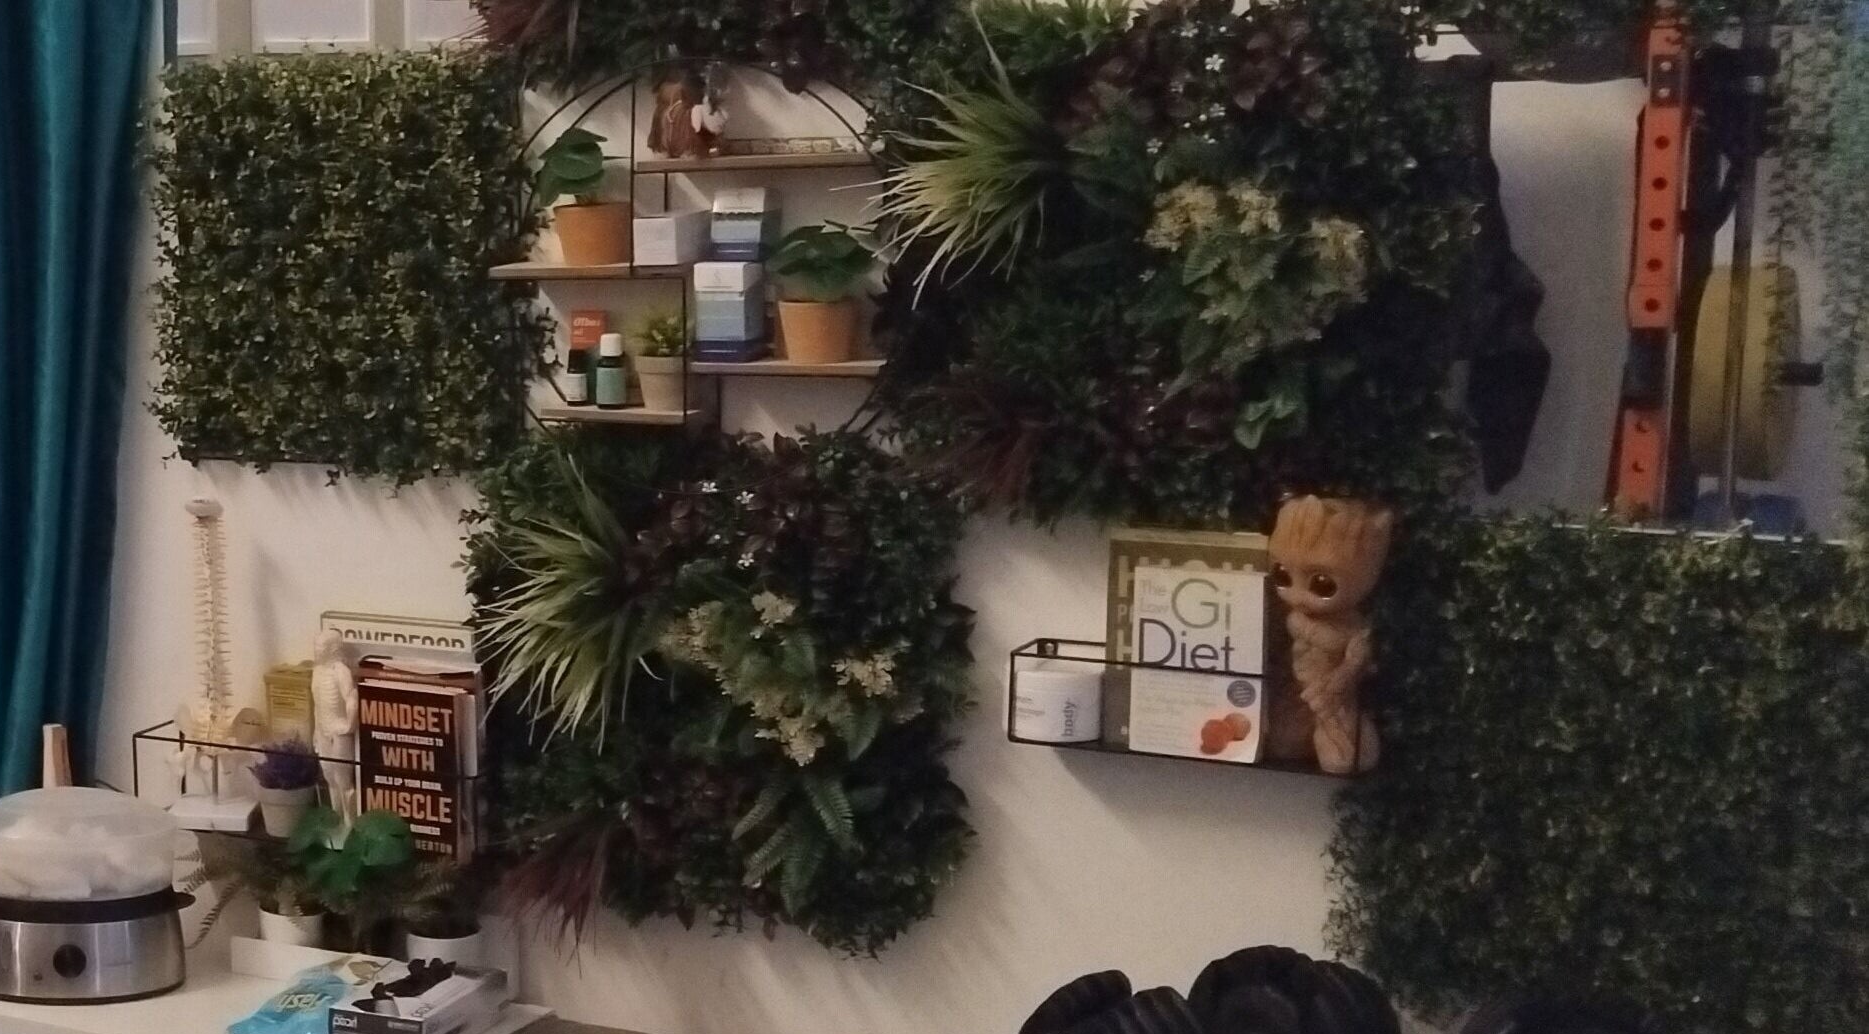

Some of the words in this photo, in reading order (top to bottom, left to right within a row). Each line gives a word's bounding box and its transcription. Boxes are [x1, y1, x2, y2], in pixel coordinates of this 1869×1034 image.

[1139, 579, 1167, 596] The
[1172, 577, 1233, 631] Gi
[1138, 617, 1235, 672] Diet
[360, 698, 453, 735] MINDSET
[381, 745, 435, 772] WITH
[366, 787, 453, 824] MUSCLE
